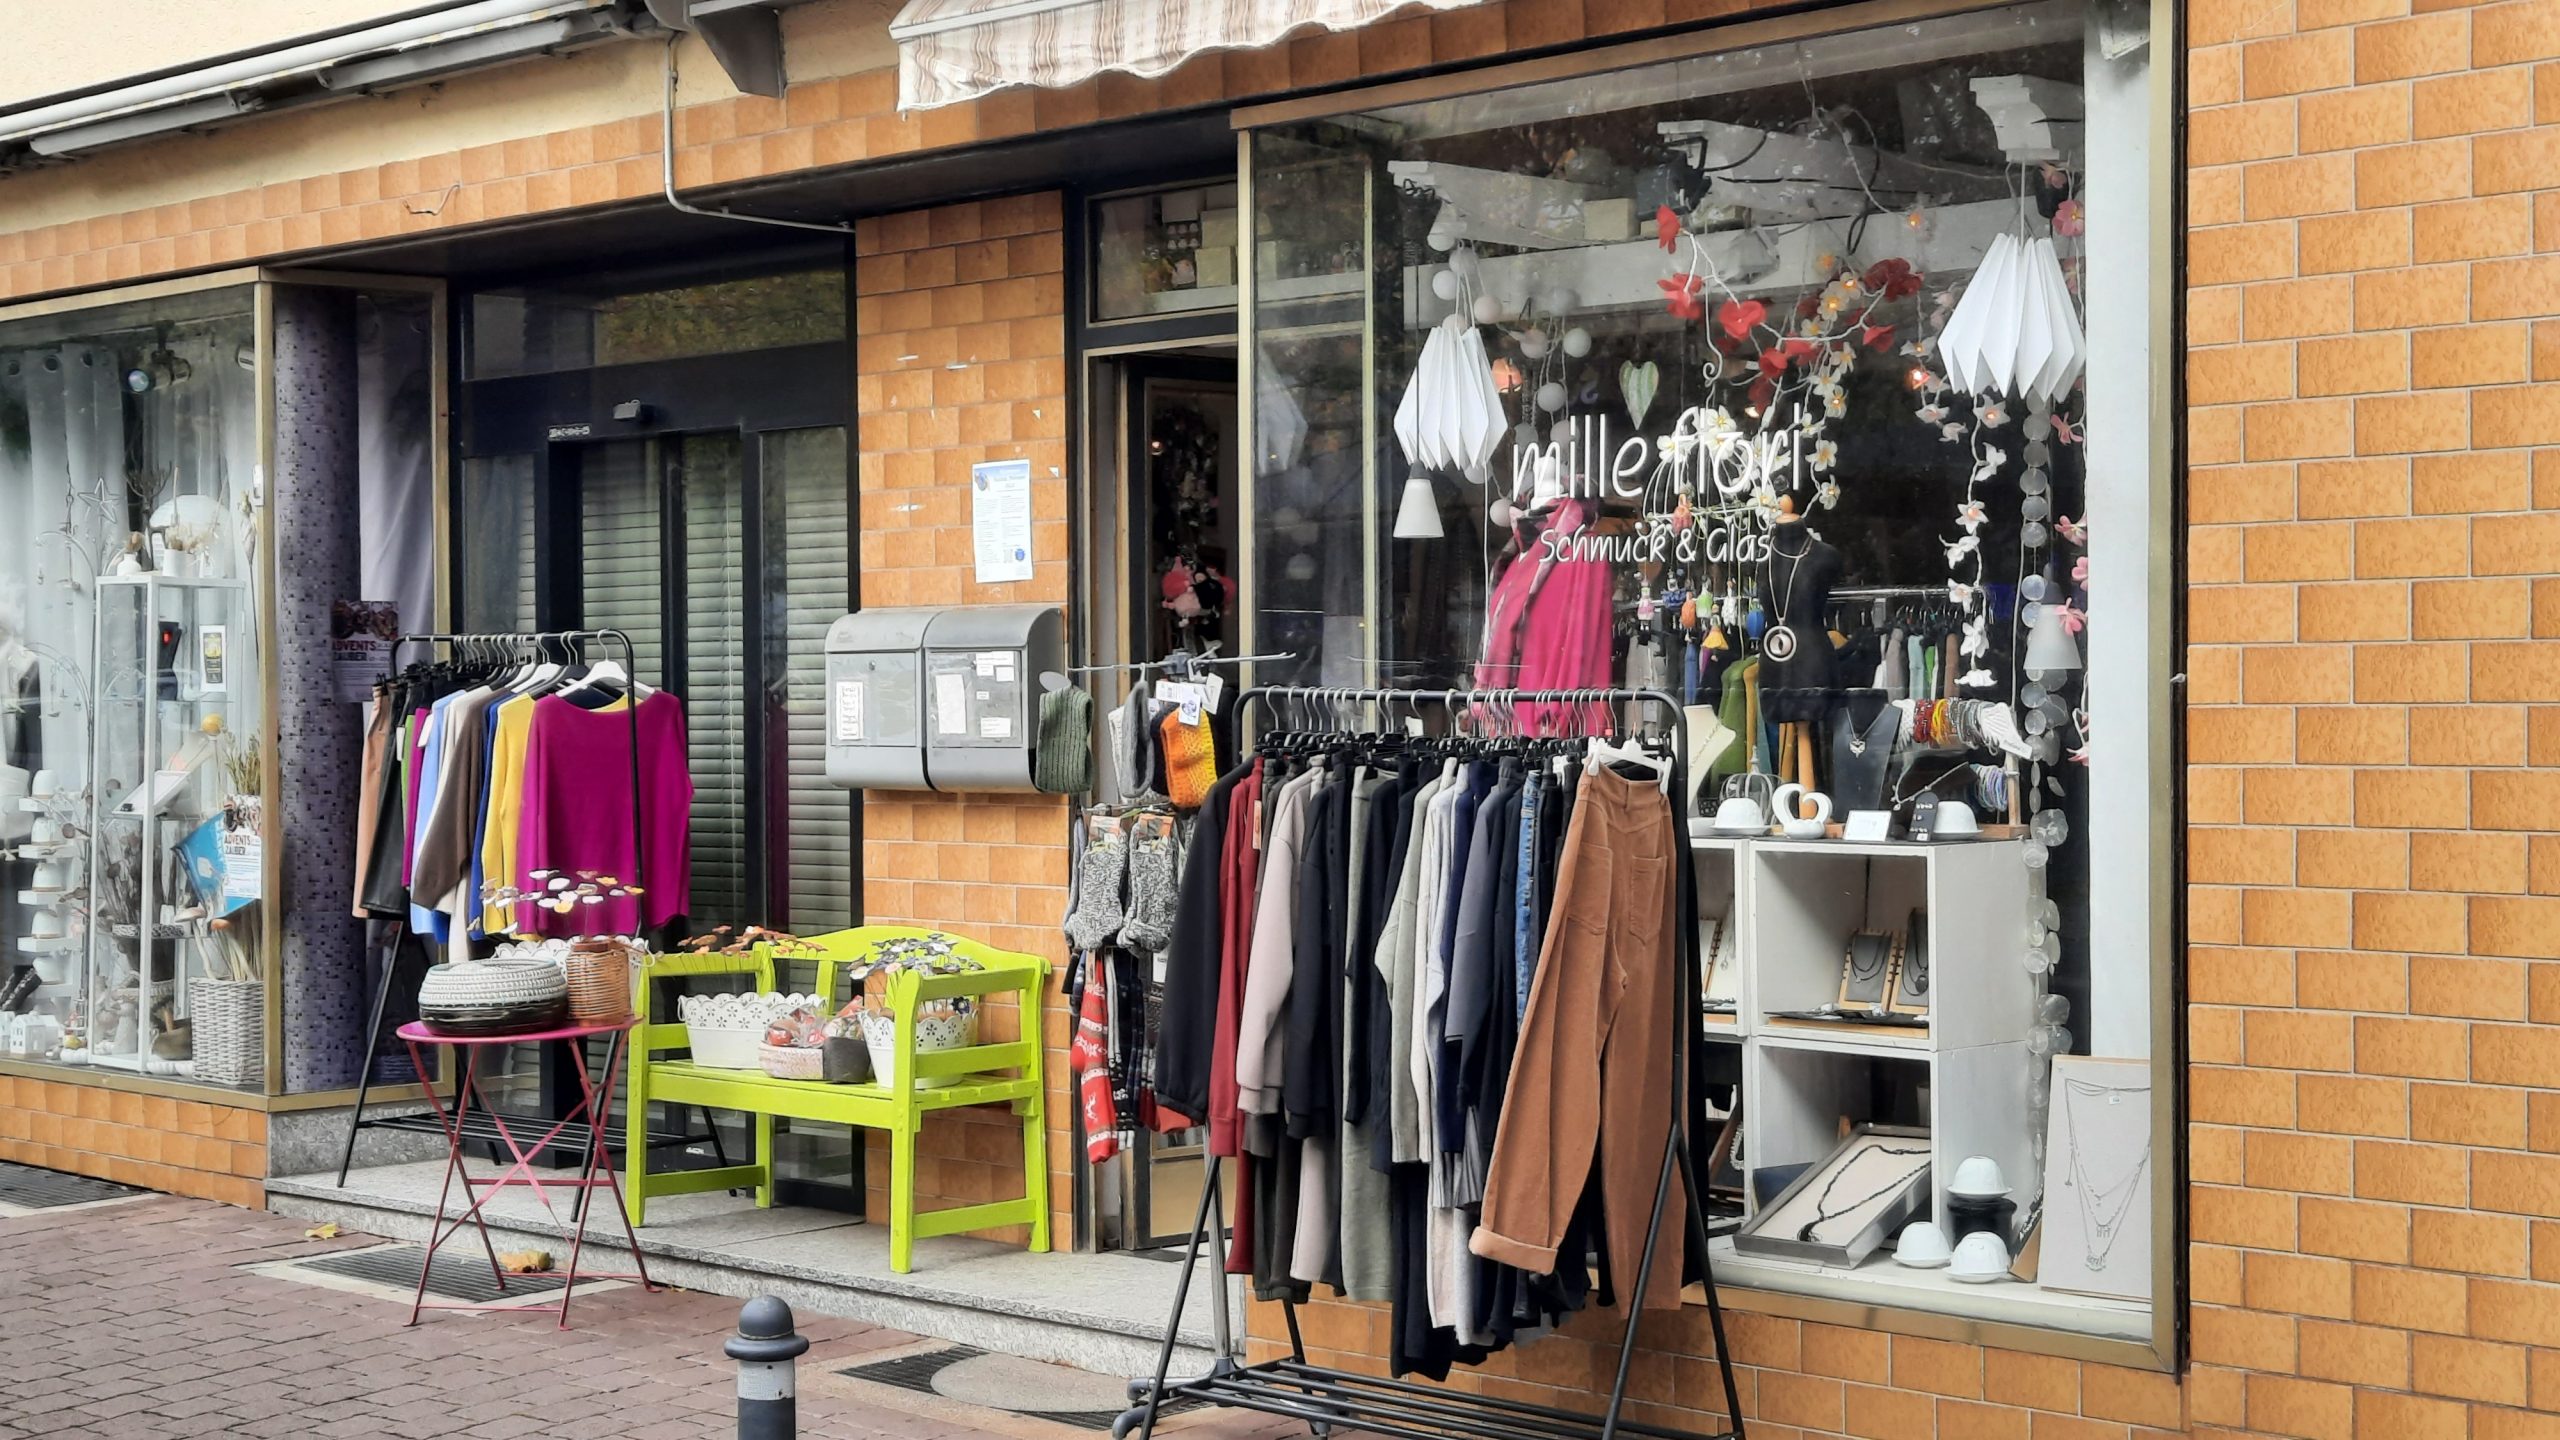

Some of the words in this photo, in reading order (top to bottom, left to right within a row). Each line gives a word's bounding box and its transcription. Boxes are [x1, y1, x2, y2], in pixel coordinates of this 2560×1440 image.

[1512, 413, 1648, 502] mille
[1671, 402, 1800, 495] fiori
[1539, 523, 1667, 563] Schmuck
[1675, 528, 1697, 563] &
[1706, 523, 1772, 563] Glas
[224, 834, 251, 846] ADVENTS
